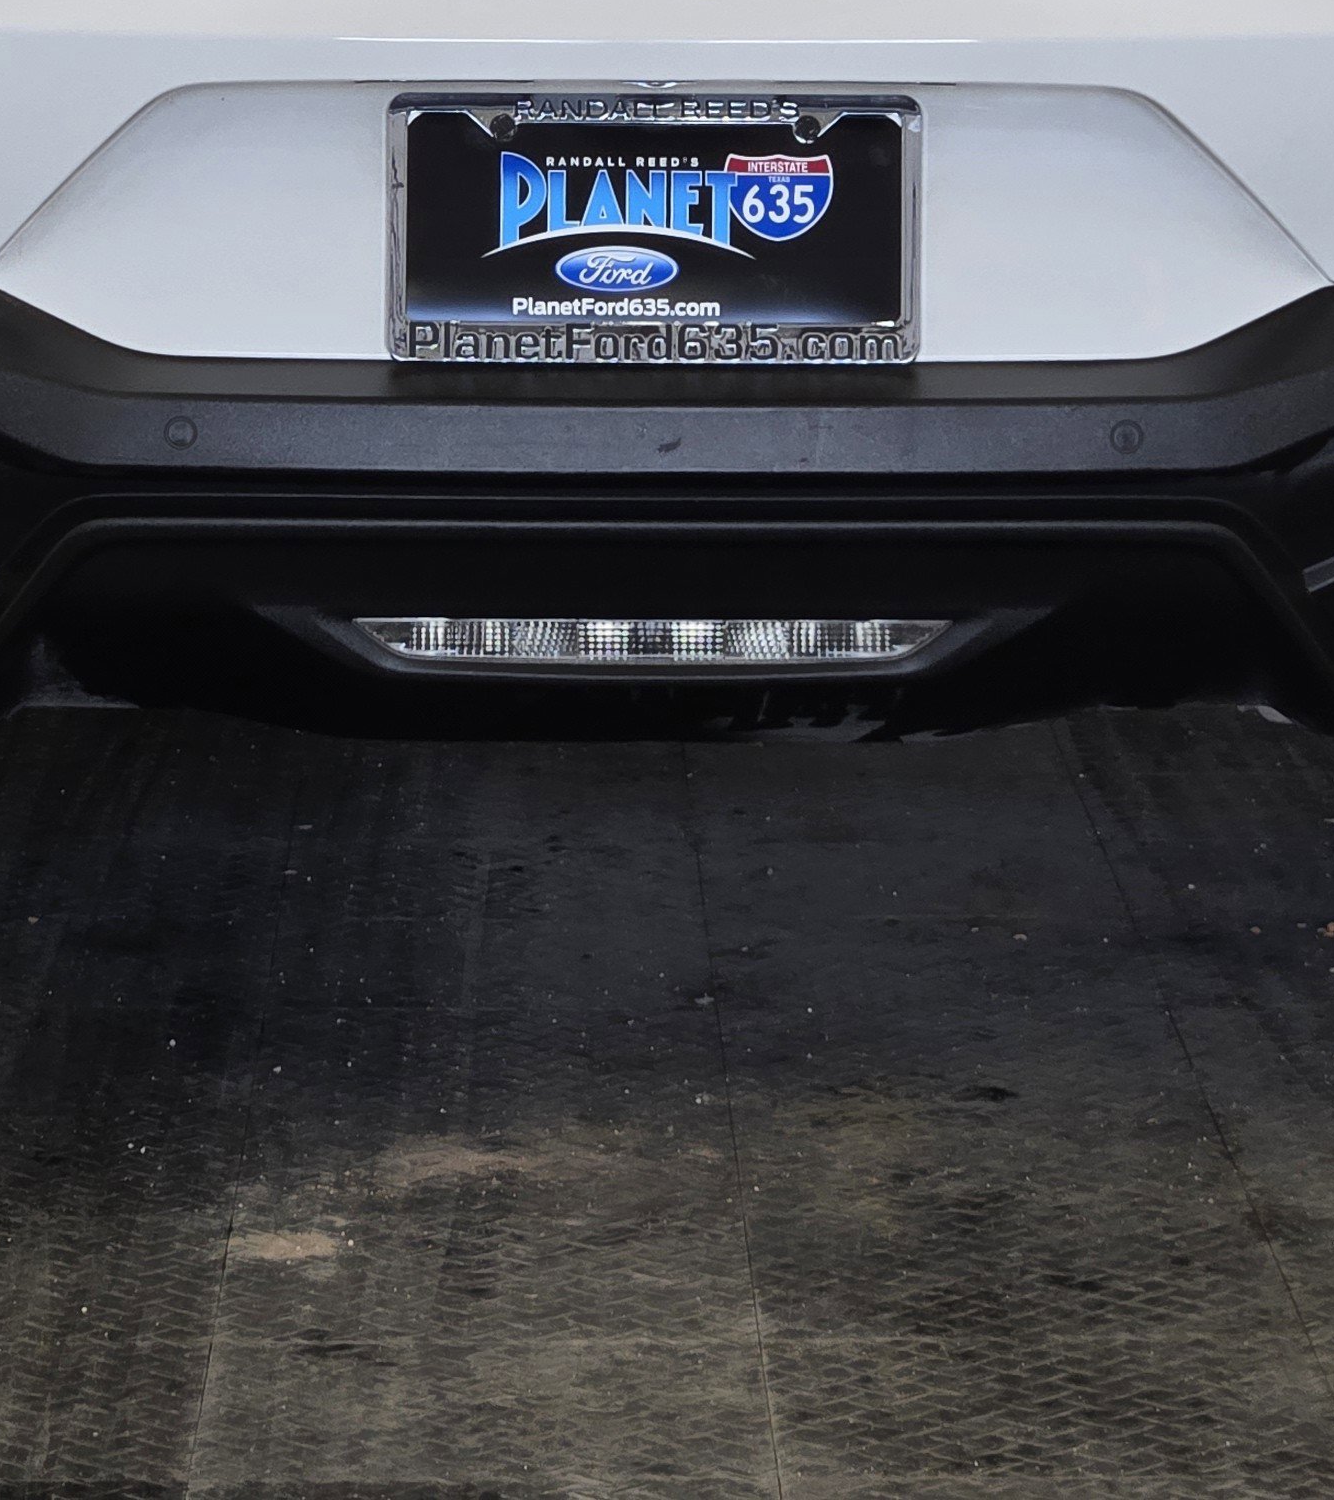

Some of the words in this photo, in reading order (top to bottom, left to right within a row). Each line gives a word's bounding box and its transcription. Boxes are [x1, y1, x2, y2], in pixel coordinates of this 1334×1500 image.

[513, 99, 676, 122] RANDALL
[546, 156, 626, 167] RANDALL
[636, 156, 699, 167] REED'S
[747, 161, 808, 173] INTERSTATE
[500, 151, 738, 248] PLANET
[742, 184, 815, 223] 635
[578, 256, 653, 288] Ford
[512, 297, 720, 317] PlanetFord635.com
[407, 322, 902, 361] PlanetFord635.com
